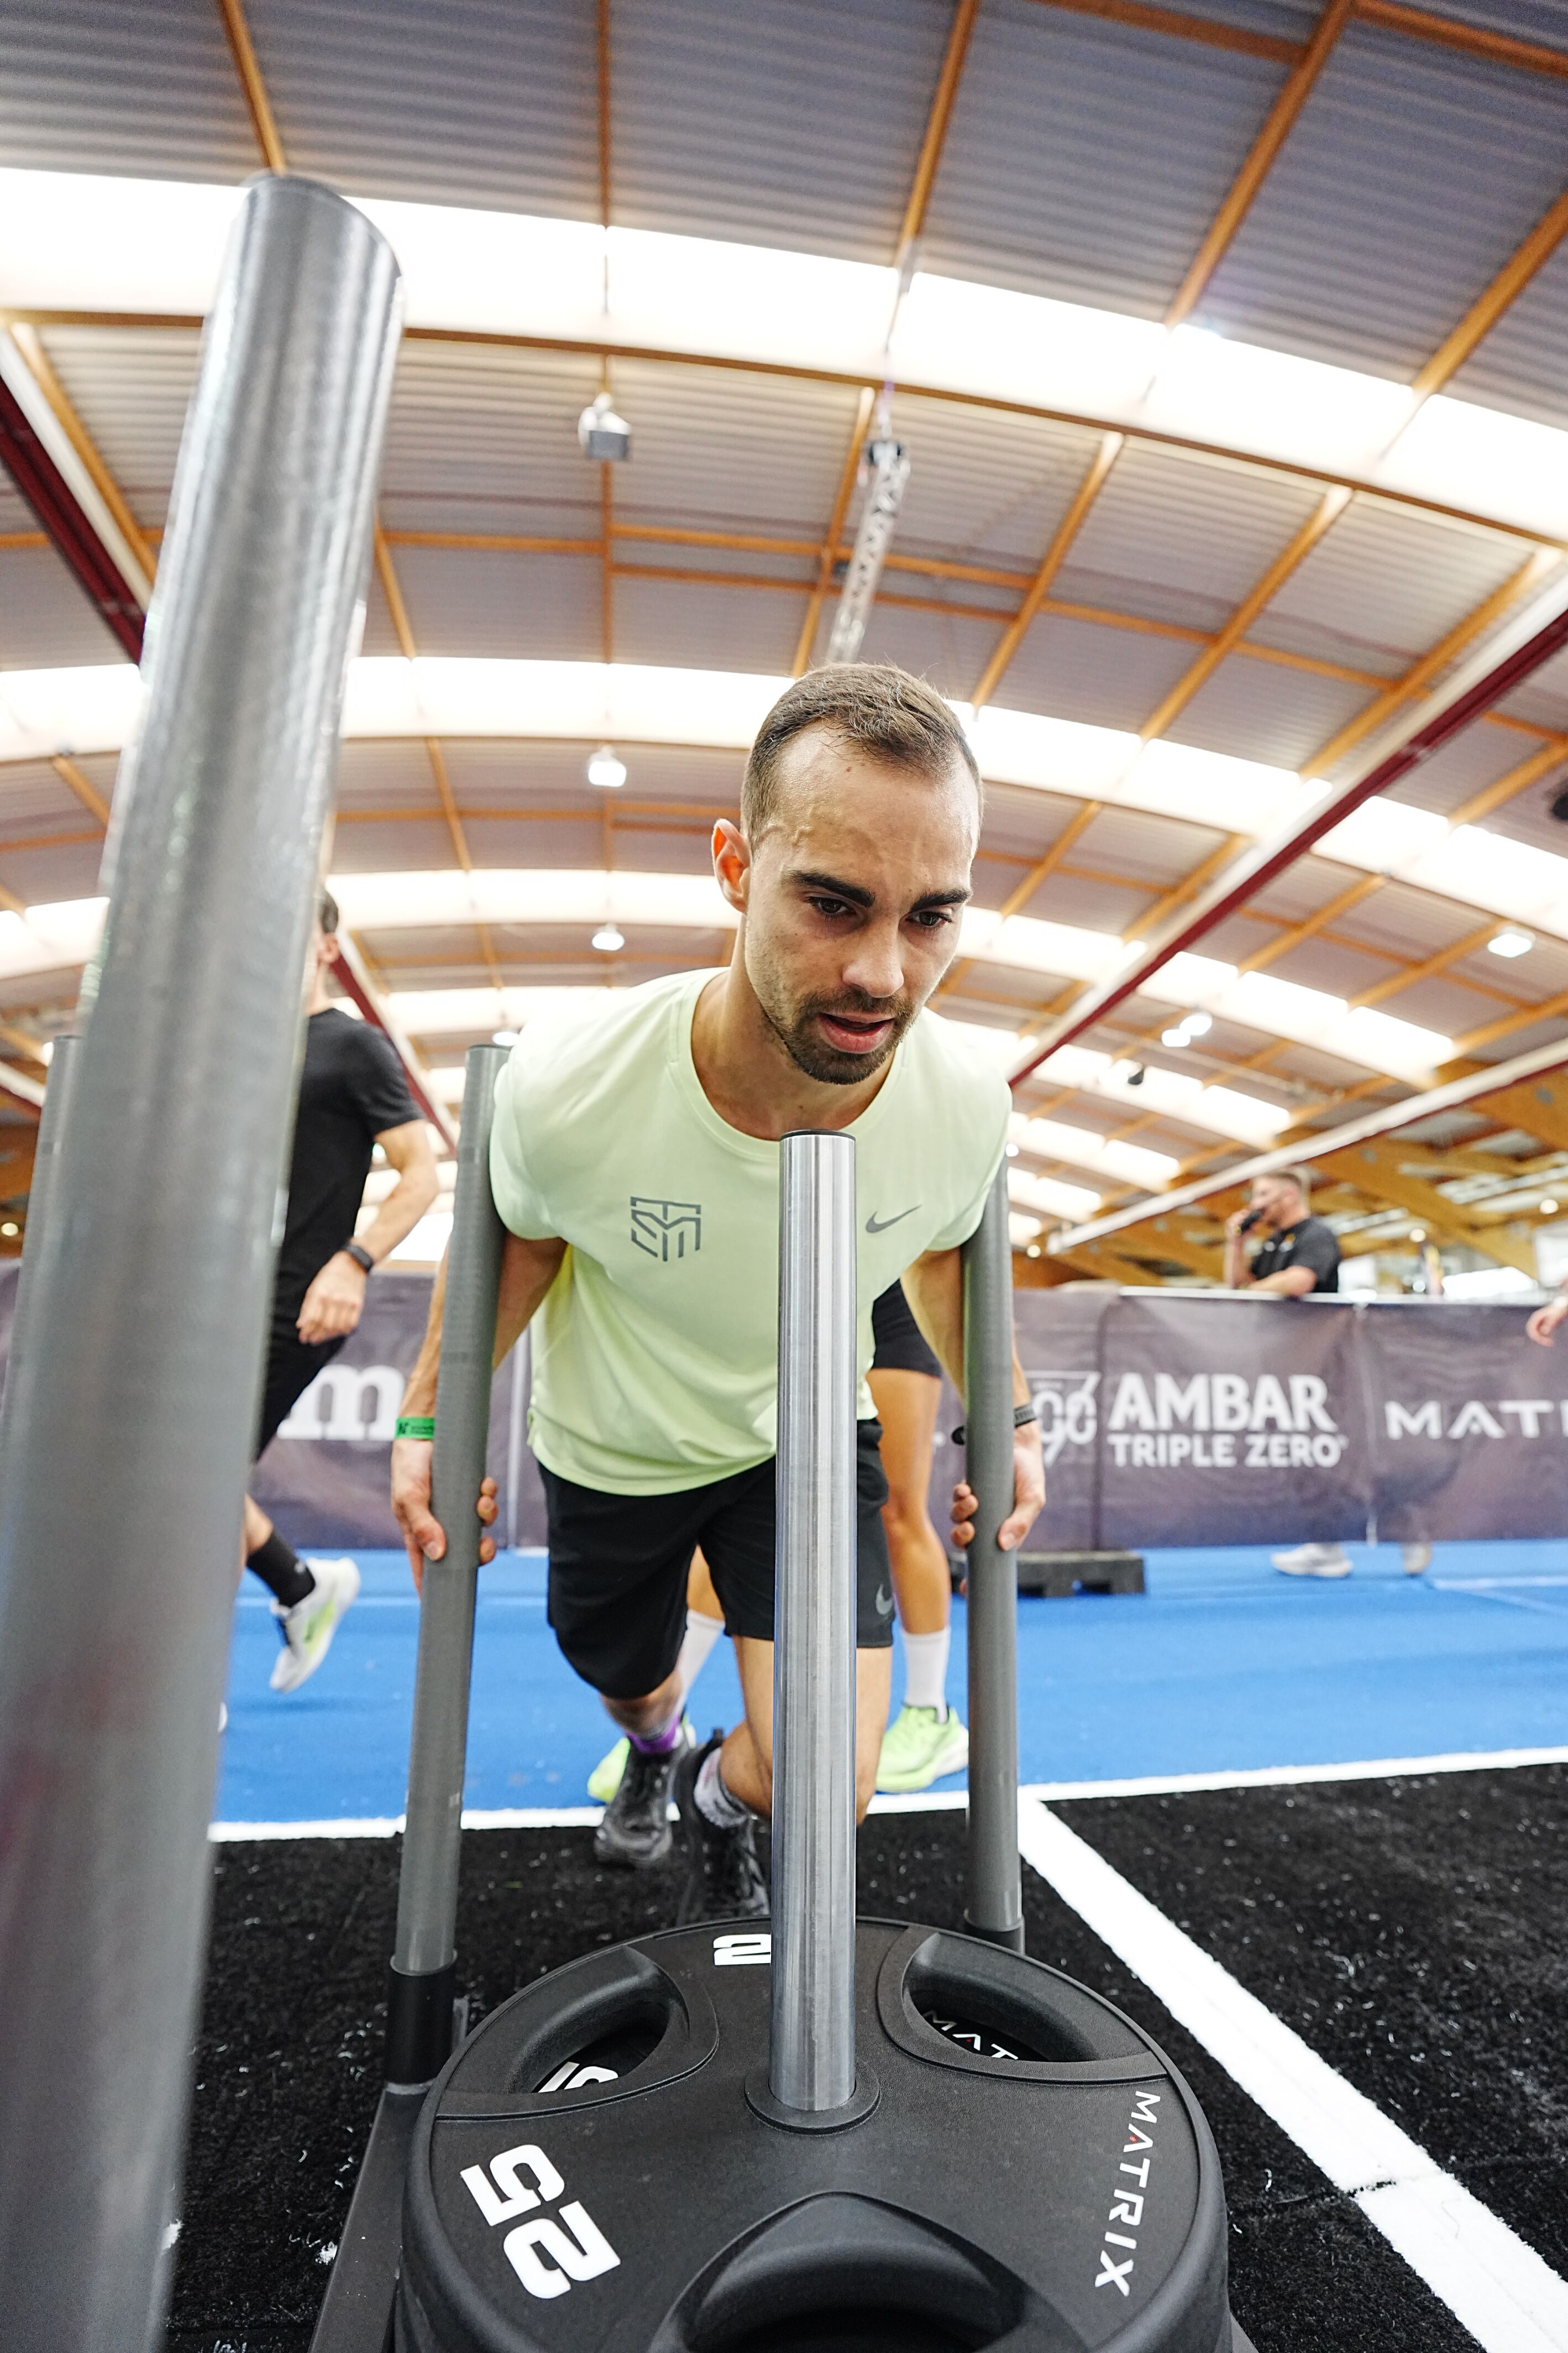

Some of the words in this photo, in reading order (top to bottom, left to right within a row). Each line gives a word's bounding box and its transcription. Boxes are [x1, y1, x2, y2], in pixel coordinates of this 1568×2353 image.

[1108, 1372, 1338, 1432] AMBAR
[1384, 1399, 1568, 1440] MAT
[1107, 1434, 1237, 1467] TRIPLE
[1245, 1434, 1341, 1467] ZERO
[713, 1933, 772, 1965] 2
[1095, 2090, 1161, 2297] MATRIX
[460, 2145, 621, 2299] 25
